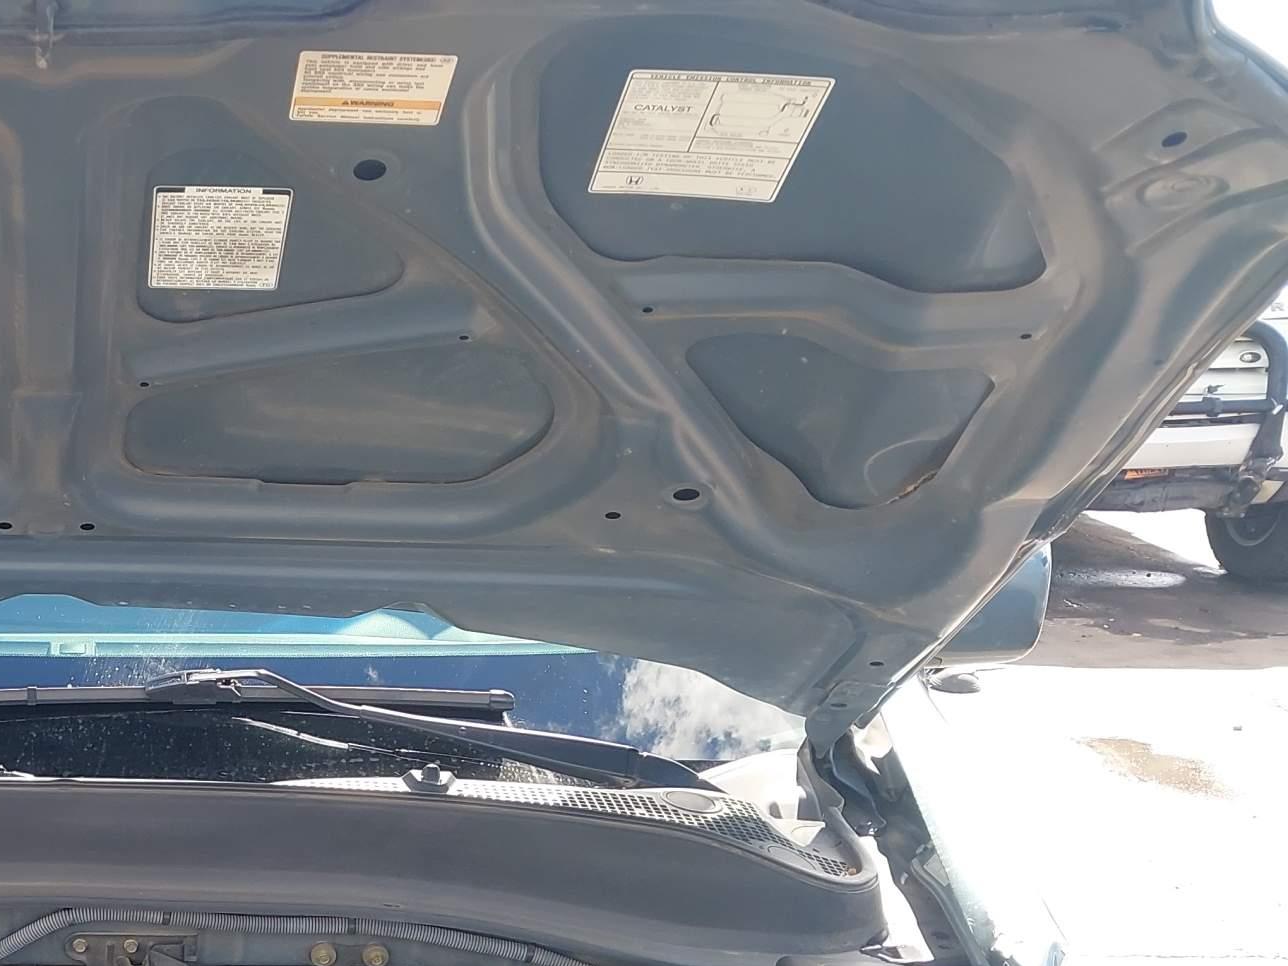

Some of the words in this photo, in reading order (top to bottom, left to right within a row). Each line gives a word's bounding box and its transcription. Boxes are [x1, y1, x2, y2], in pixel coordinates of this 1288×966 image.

[685, 74, 722, 82] EMISSION
[762, 78, 812, 86] INFORMATION
[633, 104, 693, 113] CATALYST
